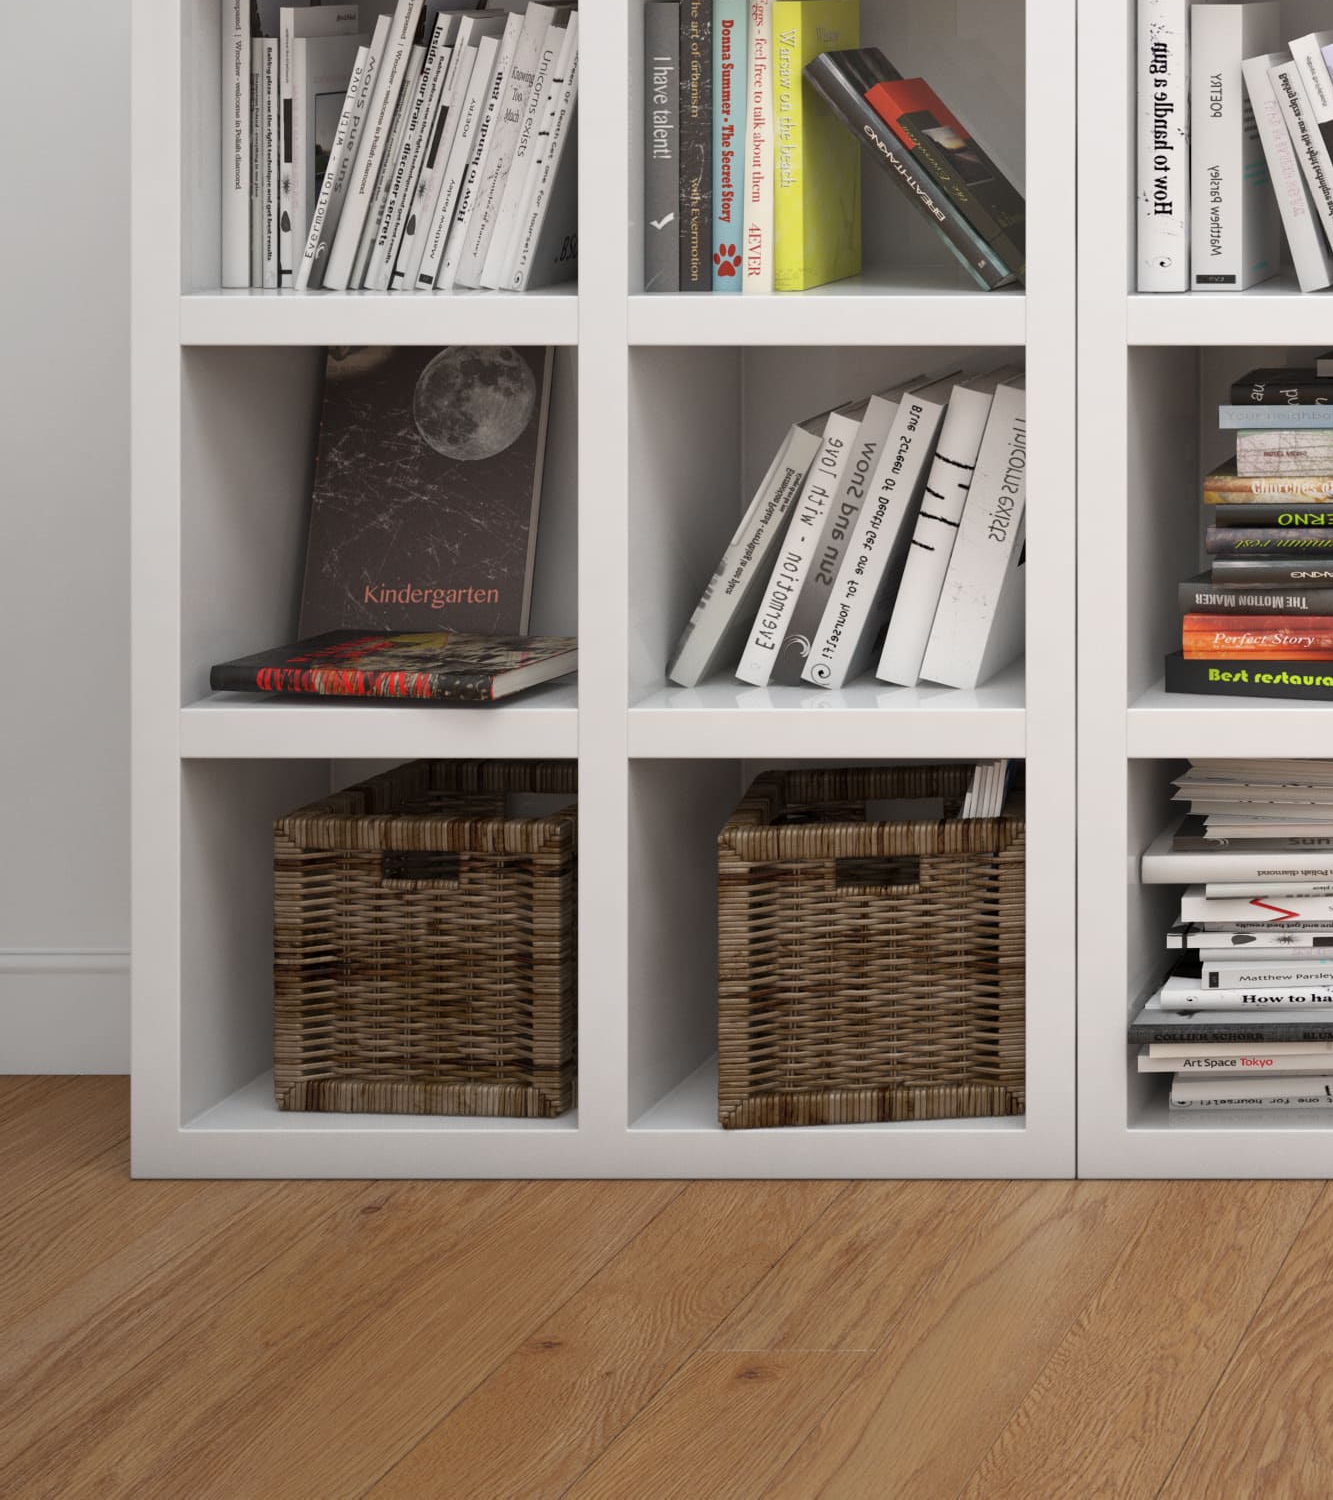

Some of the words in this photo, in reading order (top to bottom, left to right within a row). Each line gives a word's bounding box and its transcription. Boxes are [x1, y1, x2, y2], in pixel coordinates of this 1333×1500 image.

[425, 25, 443, 65] Inside
[722, 20, 734, 61] Donna
[755, 38, 767, 61] feel
[780, 28, 796, 88] Warsaw
[420, 66, 430, 97] your
[654, 67, 674, 104] have
[722, 63, 734, 115] Summer
[753, 64, 767, 87] free
[754, 90, 763, 104] to
[781, 92, 794, 113] on
[410, 99, 423, 131] brain
[753, 106, 766, 130] talk
[782, 116, 796, 141] the
[653, 110, 674, 158] talent!
[722, 124, 734, 147] The
[752, 132, 767, 167] about
[393, 143, 411, 198] discover
[722, 150, 734, 188] Secret
[781, 145, 796, 188] beach
[864, 125, 946, 221] BREATHTAKING
[752, 171, 765, 203] them
[379, 200, 395, 245] secrets
[720, 191, 734, 222] Story
[747, 223, 762, 276] 4EVER
[364, 583, 499, 608] Kindergarten
[1214, 633, 1270, 646] Perfect
[1272, 633, 1315, 647] Story
[1209, 668, 1248, 682] Best
[1184, 1058, 1202, 1067] Art
[1204, 1058, 1237, 1068] Space
[1240, 1057, 1273, 1068] Tokyo
